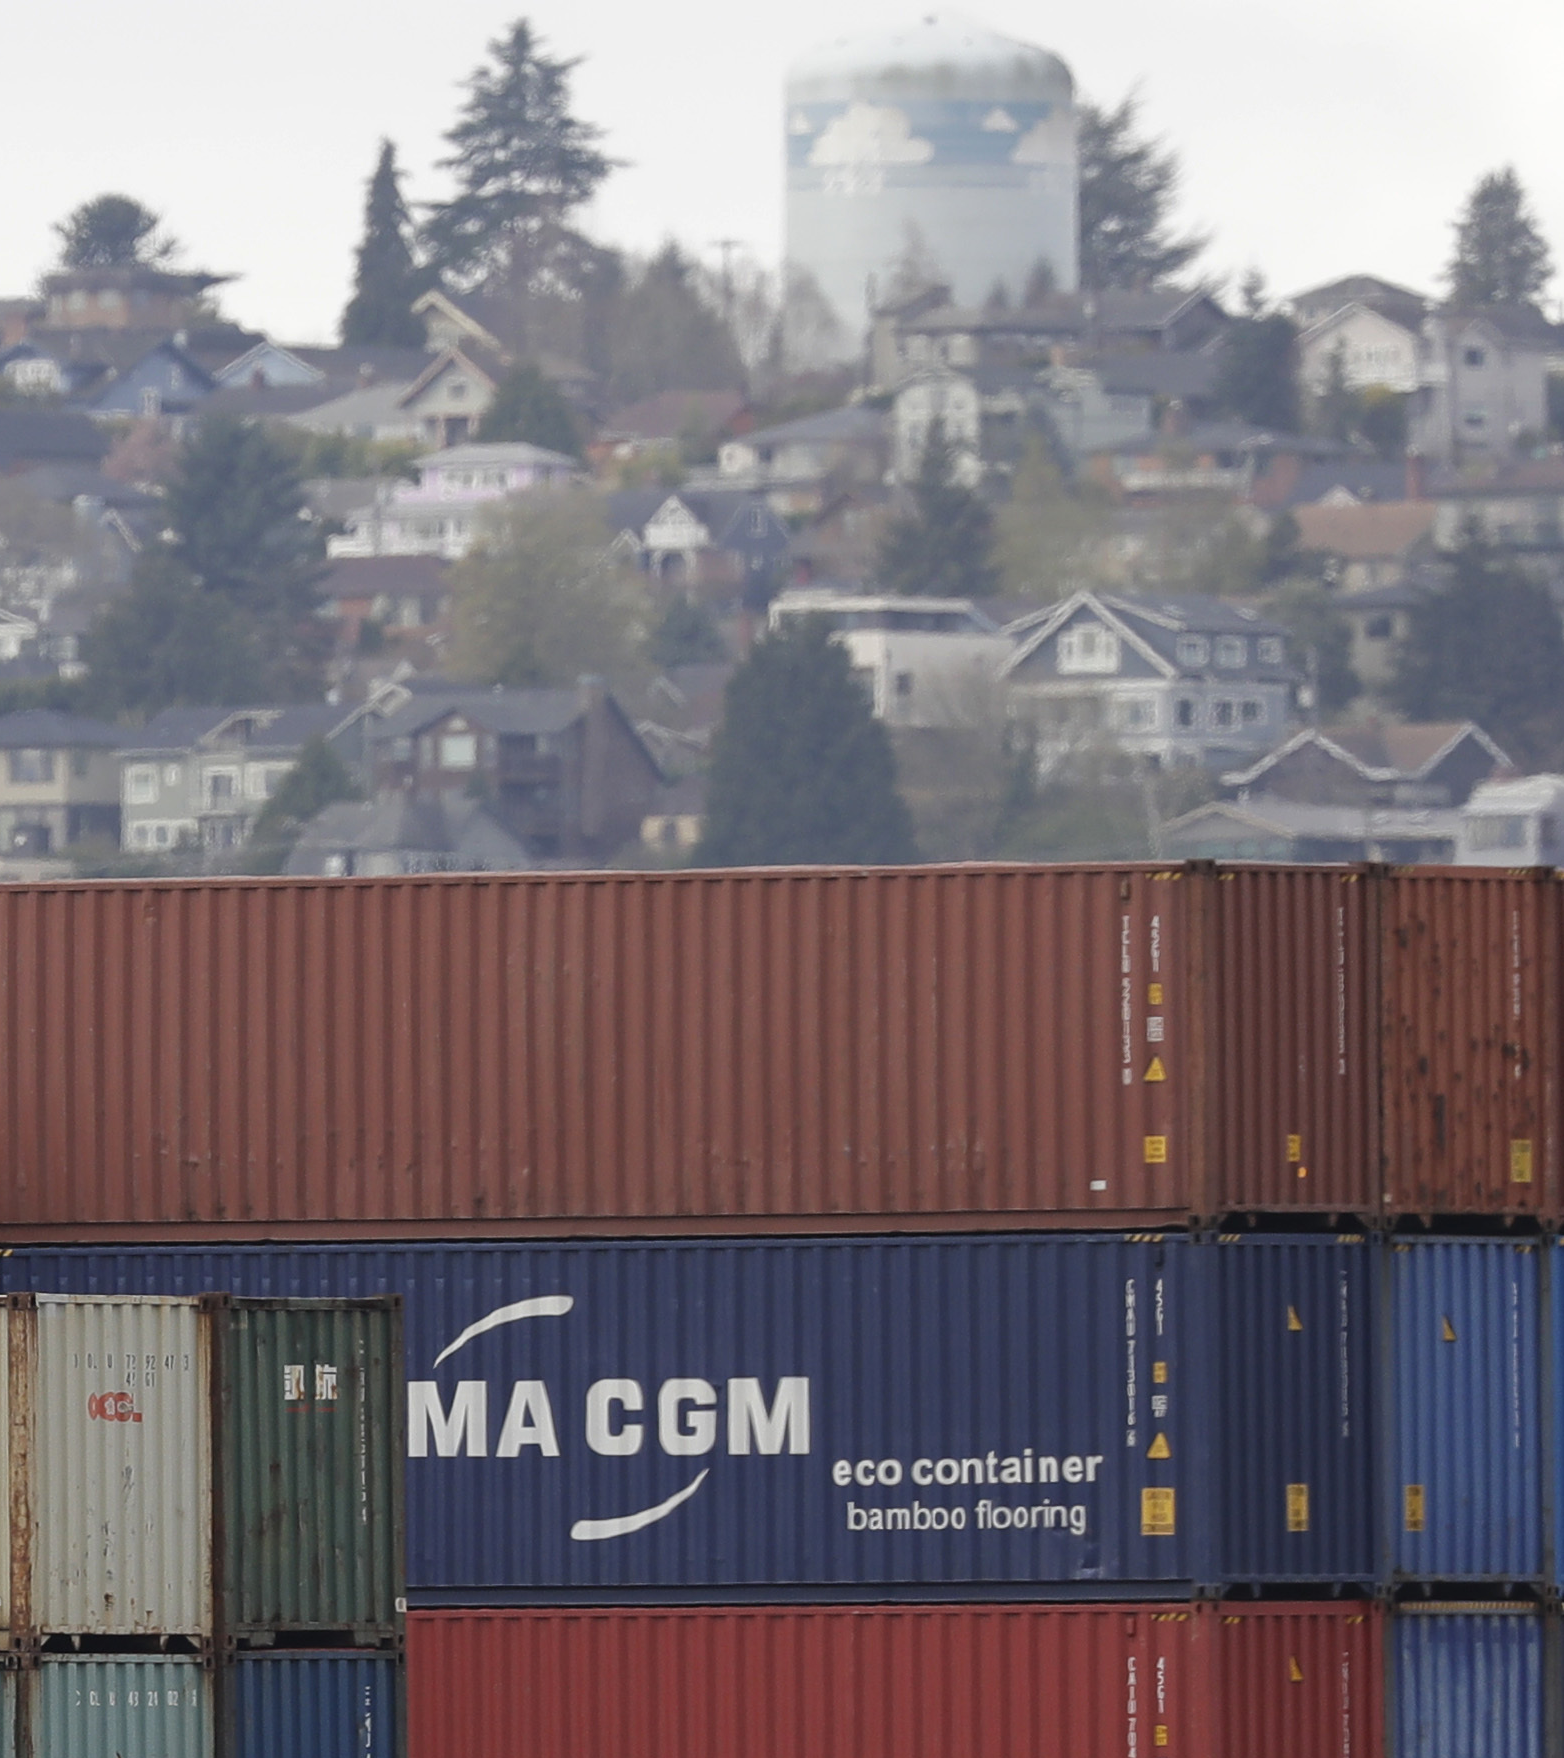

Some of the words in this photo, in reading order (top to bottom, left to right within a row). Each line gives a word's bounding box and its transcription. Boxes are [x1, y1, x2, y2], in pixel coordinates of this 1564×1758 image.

[407, 1379, 561, 1458] MA
[585, 1376, 811, 1457] CGM
[831, 1454, 903, 1487] eco
[911, 1448, 1103, 1487] container
[847, 1501, 967, 1532] bamboo
[974, 1499, 1087, 1536] flooring
